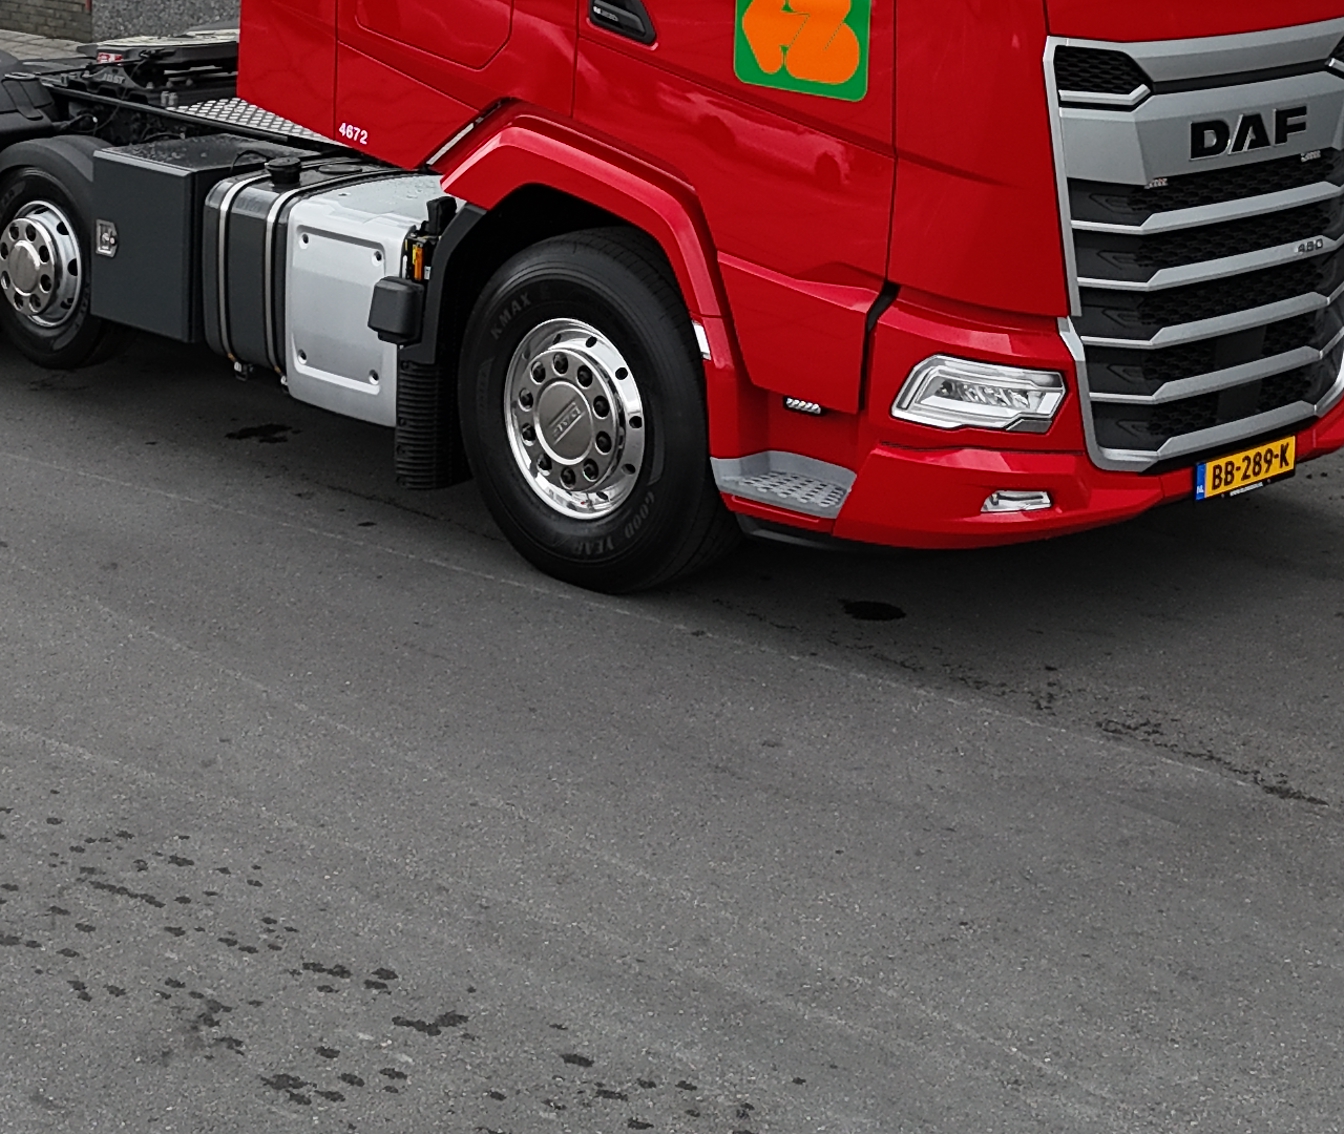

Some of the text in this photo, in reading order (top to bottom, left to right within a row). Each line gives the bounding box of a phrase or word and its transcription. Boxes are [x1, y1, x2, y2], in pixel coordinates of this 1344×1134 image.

[338, 122, 368, 145] 4672
[1189, 105, 1307, 162] DAF
[1211, 441, 1290, 491] BB-289-K
